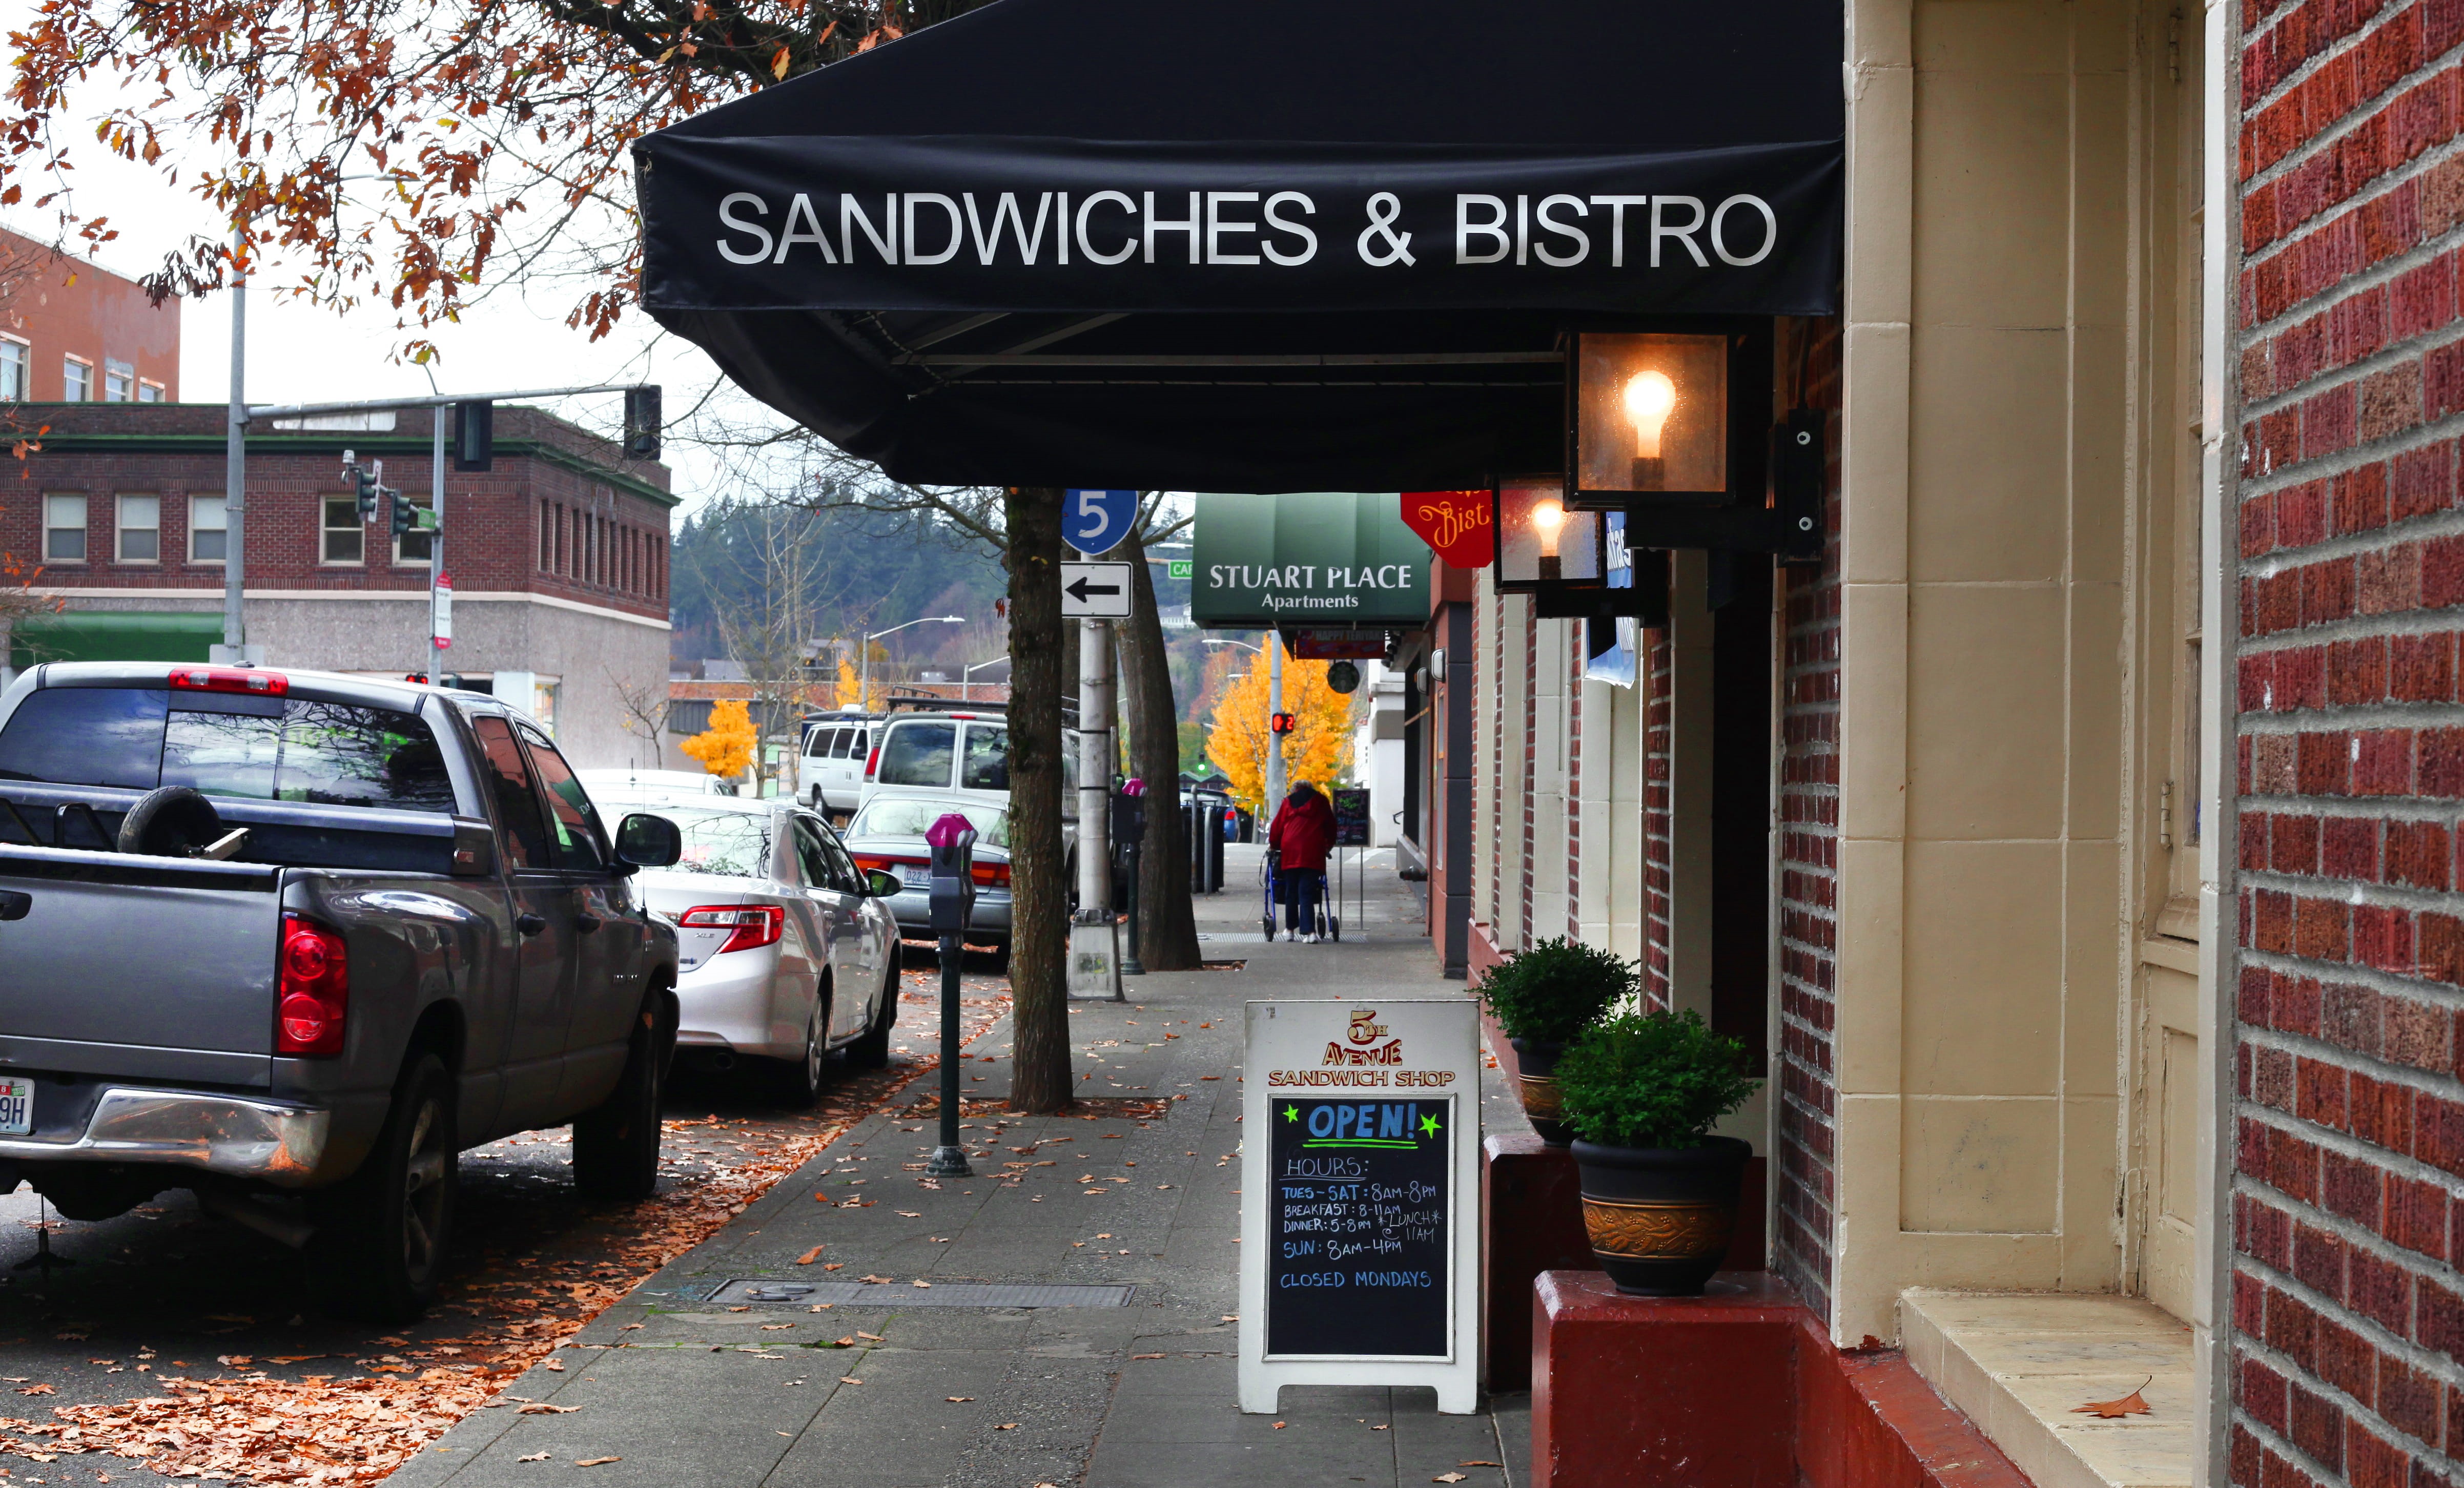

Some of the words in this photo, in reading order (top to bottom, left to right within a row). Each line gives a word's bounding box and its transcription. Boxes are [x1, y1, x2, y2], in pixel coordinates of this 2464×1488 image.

[716, 191, 1318, 266] SANDWICHES
[1358, 192, 1416, 266] &
[1456, 194, 1777, 267] BISTRO
[1078, 491, 1109, 538] 5
[1419, 501, 1493, 548] Bist
[1210, 565, 1316, 589] STUART
[1328, 565, 1411, 589] PLACE
[1261, 593, 1359, 612] Apartments
[1316, 630, 1344, 640] HAPPY
[1286, 716, 1295, 730] 2
[1322, 1039, 1402, 1066] AVENUE
[1268, 1070, 1388, 1086] SANDWICH
[1395, 1070, 1455, 1086] SHOP
[1308, 1103, 1416, 1139] OPEN!
[1287, 1157, 1369, 1176] HOURS:
[1407, 1226, 1434, 1244] 11AM
[1280, 1273, 1345, 1288] CLOSED
[1356, 1271, 1431, 1287] MONDAYS
